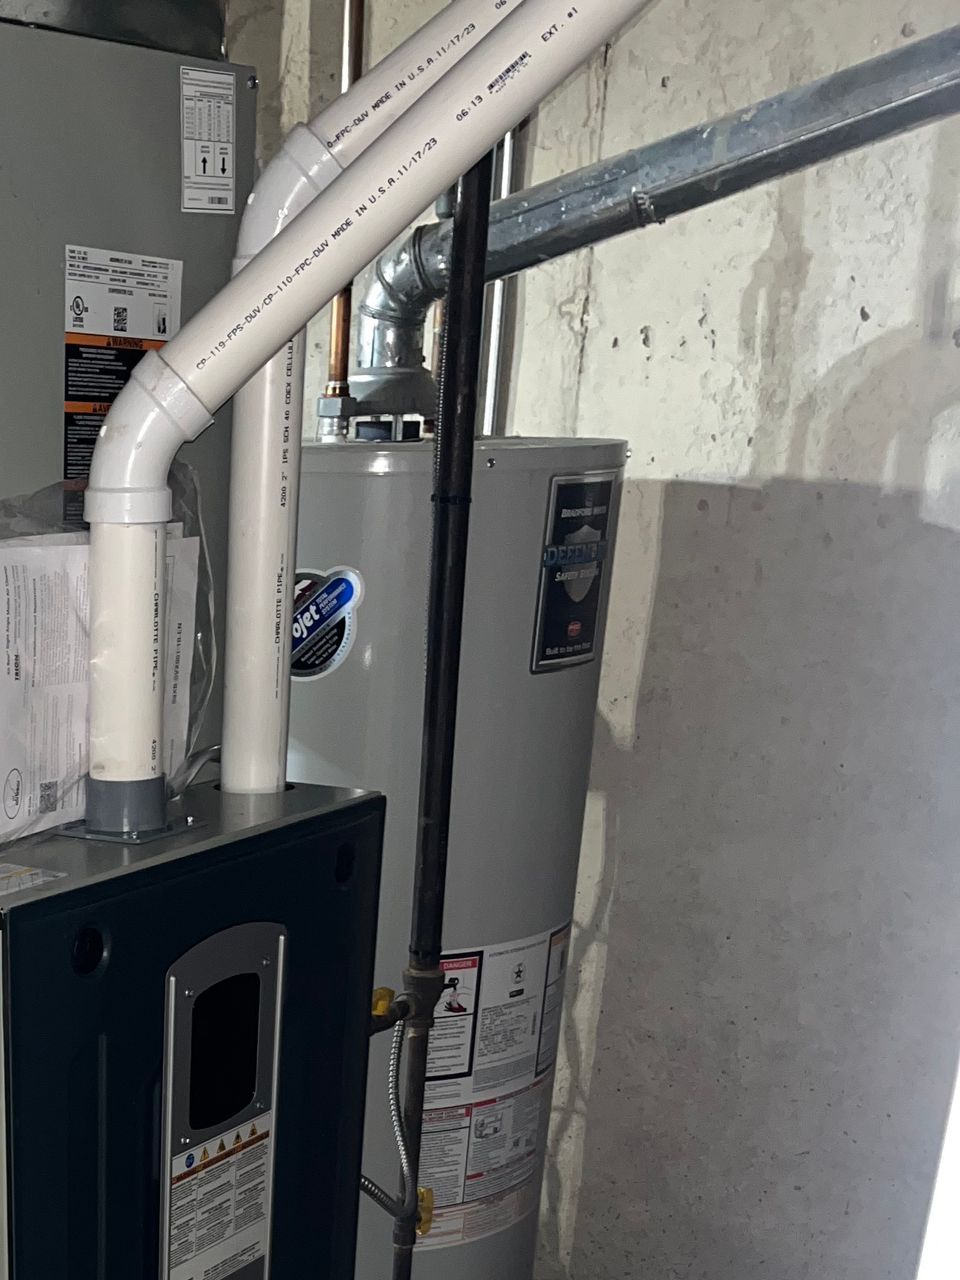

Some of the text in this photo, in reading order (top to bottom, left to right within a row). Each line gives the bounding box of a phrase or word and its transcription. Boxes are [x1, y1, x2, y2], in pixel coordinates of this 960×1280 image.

[371, 90, 393, 112] MADE
[395, 79, 408, 92] IN
[331, 217, 354, 241] MADE
[355, 203, 369, 218] IN
[455, 94, 485, 122] 06:13
[111, 338, 143, 349] WARNING
[285, 382, 293, 405] COEX
[284, 410, 290, 421] 40
[280, 486, 288, 508] 4200
[152, 592, 160, 645] CHARLOTTE
[275, 598, 283, 645] CHARLOTTE
[151, 647, 159, 673] PIPE
[443, 960, 473, 970] DANGER
